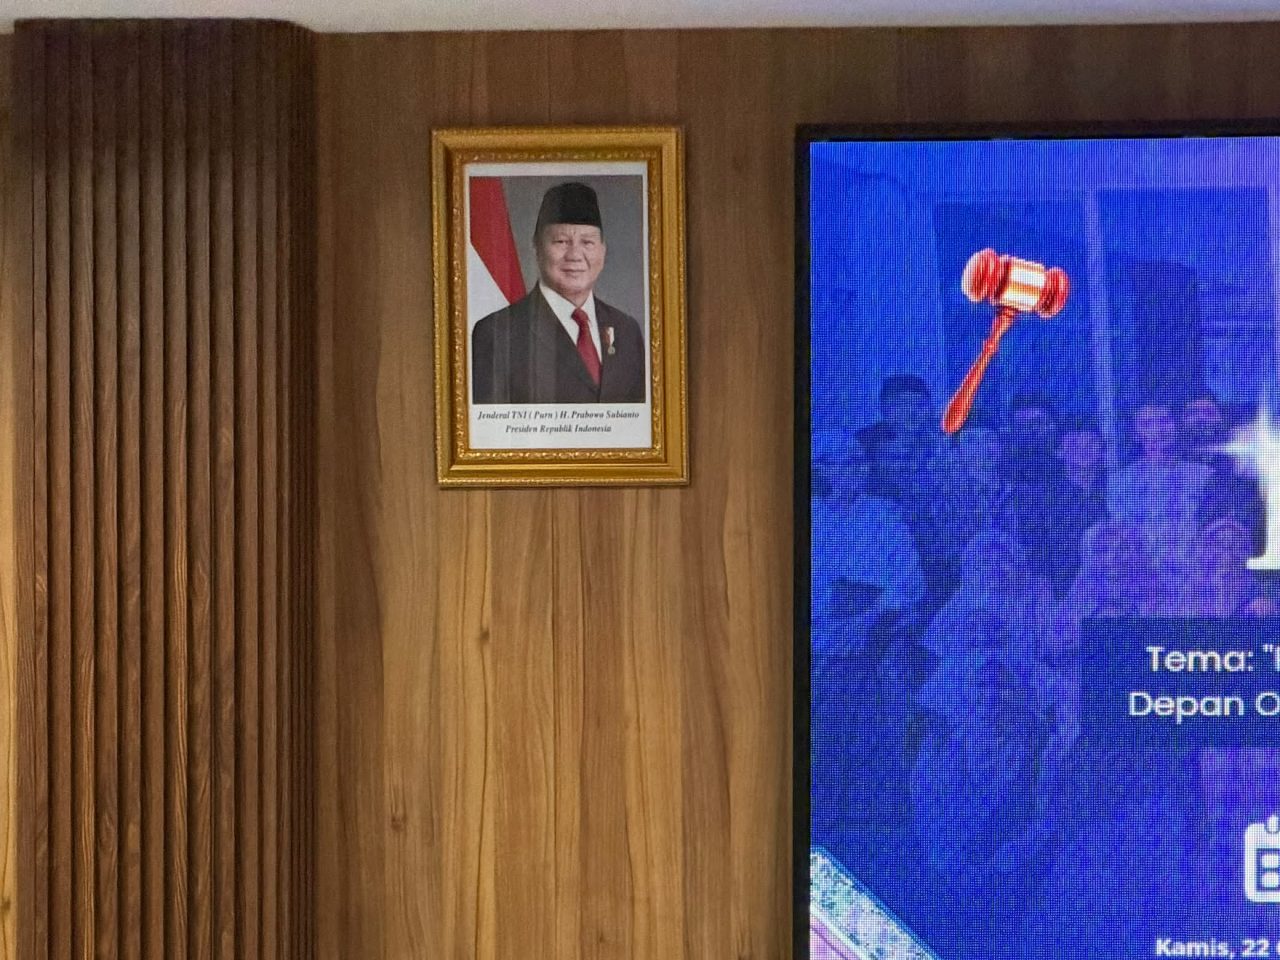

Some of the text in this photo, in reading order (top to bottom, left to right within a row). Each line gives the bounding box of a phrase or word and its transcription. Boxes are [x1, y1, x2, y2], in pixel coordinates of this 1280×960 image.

[478, 410, 510, 420] Jenderal
[512, 410, 527, 419] TNI
[572, 410, 604, 419] Prabowo
[606, 410, 639, 419] Subianto
[506, 424, 612, 435] Presiden Republik Indonesia
[1146, 645, 1254, 672] Tema:
[1129, 692, 1245, 724] Depan
[1156, 938, 1235, 960] Kamis,
[1241, 939, 1270, 958] 22
